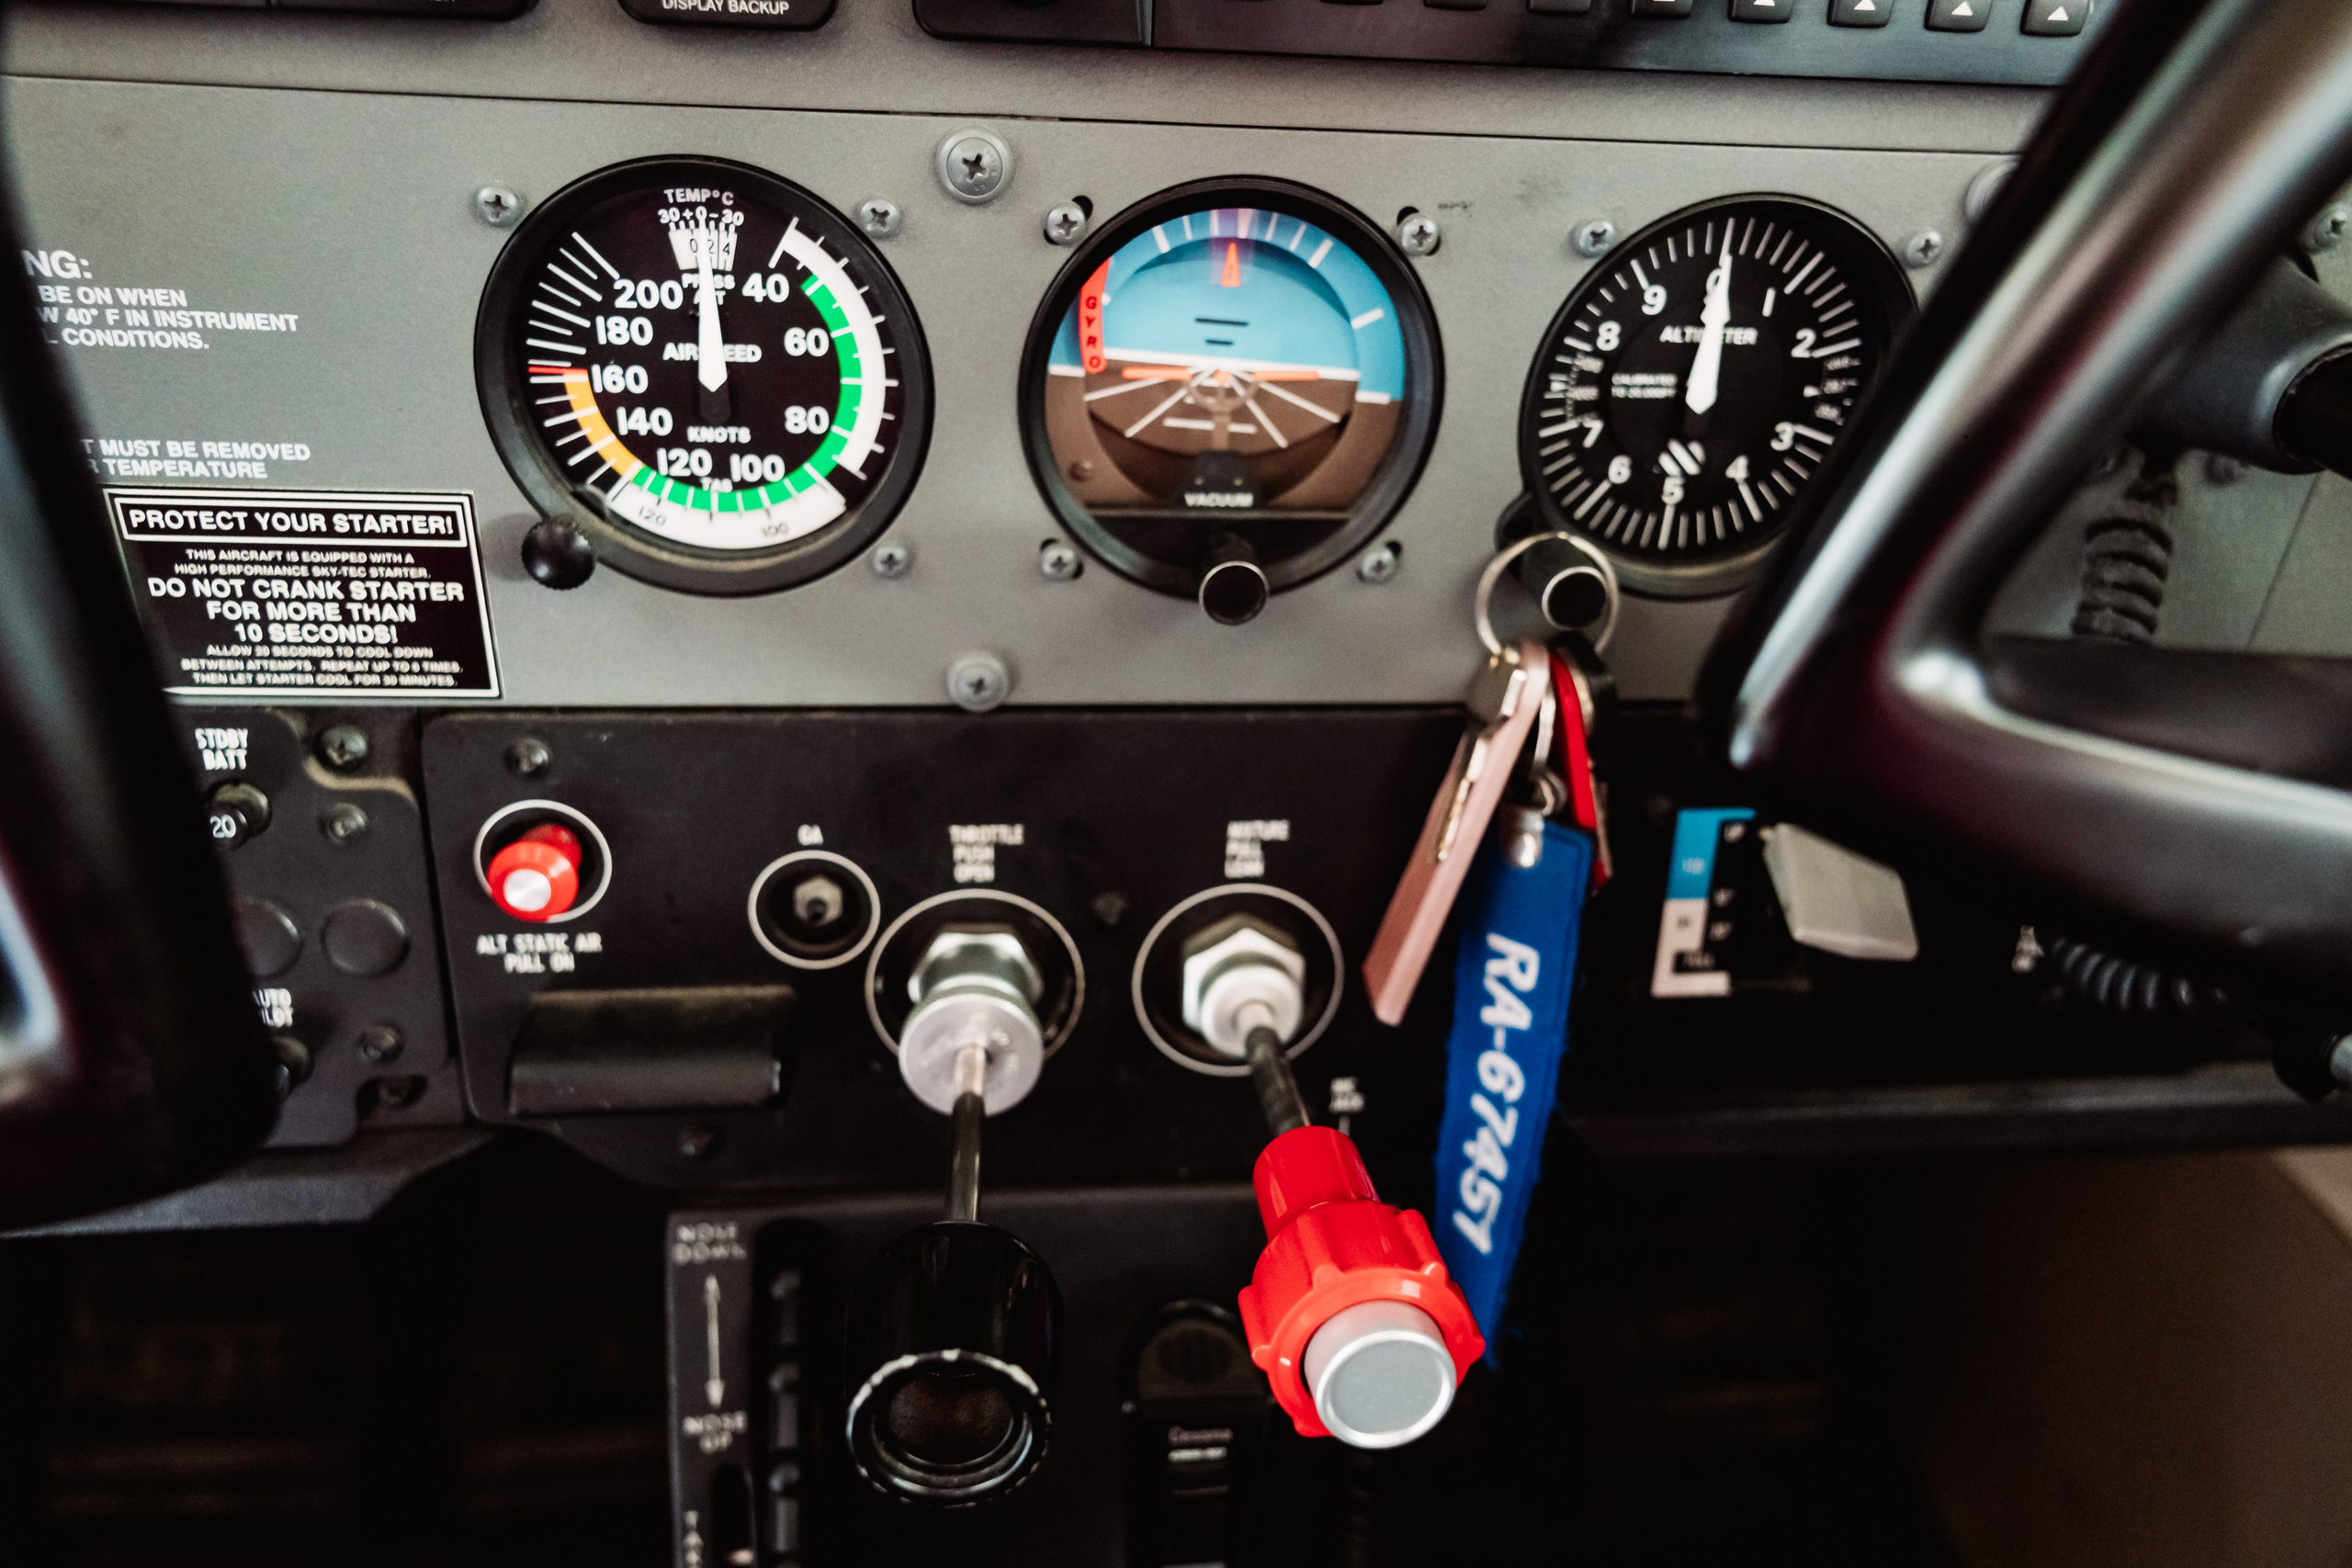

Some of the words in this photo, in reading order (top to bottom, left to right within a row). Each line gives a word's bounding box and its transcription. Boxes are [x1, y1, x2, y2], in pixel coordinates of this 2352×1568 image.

[662, 0, 723, 12] DISPLAY
[728, 0, 789, 15] BACKUP
[722, 242, 730, 256] 4
[681, 273, 735, 289] PRSS
[741, 273, 790, 303] 40
[38, 285, 74, 304] BE
[76, 286, 113, 305] ON
[114, 288, 187, 307] WHEN
[613, 278, 684, 310] 200
[1642, 285, 1667, 315] 9
[1762, 287, 1776, 317] 1
[65, 308, 98, 326] 40°
[105, 309, 119, 326] F
[124, 310, 150, 327] IN
[153, 310, 299, 332] INSTRUMENT
[594, 315, 654, 346] 180
[1085, 296, 1101, 368] GYRO
[62, 327, 210, 349] CONDITIONS.
[784, 327, 829, 357] 60
[1596, 321, 1621, 351] 8
[1791, 328, 1816, 357] 2
[662, 342, 763, 363] AIREED
[591, 364, 649, 394] 160
[616, 406, 673, 437] 140
[785, 405, 830, 435] 80
[686, 425, 752, 444] KNOTS
[1582, 418, 1604, 447] 7
[1770, 421, 1794, 451] 3
[99, 439, 160, 457] MUST
[166, 441, 198, 458] BE
[202, 441, 311, 460] REMOVED
[103, 458, 267, 479] TEMPERATURE
[656, 446, 713, 477] 120
[729, 453, 786, 483] 100
[1608, 455, 1632, 484] 6
[1725, 456, 1749, 479] 4
[1184, 491, 1253, 508] VACUUM
[1661, 476, 1685, 504] 5
[129, 509, 248, 531] PROTECT
[254, 512, 326, 533] YOUR
[332, 513, 455, 535] STARTER!
[639, 507, 667, 526] 120
[762, 523, 789, 537] 100
[186, 548, 216, 561] THIS
[219, 549, 283, 562] AIRCRAFT
[286, 551, 300, 563] IS
[300, 550, 368, 563] EQUIPPED
[368, 551, 402, 563] WITH
[404, 552, 414, 564] A
[174, 563, 208, 575] HIGH
[209, 563, 310, 577] PERFORMANCE
[311, 566, 368, 578] SKY-TEC
[147, 577, 187, 598] DO
[193, 578, 245, 598] NOT
[253, 579, 345, 600] CRANK
[349, 581, 465, 602] STARTER
[206, 600, 261, 621] FOR
[266, 601, 343, 622] MORE
[346, 603, 416, 623] THAN
[234, 623, 263, 642] 10
[267, 623, 399, 644] SECONDS!
[206, 644, 253, 657] ALLOW
[271, 645, 334, 658] SECONDS
[335, 646, 355, 659] TO
[355, 646, 392, 659] COOL
[392, 646, 434, 659] DOWN
[181, 658, 244, 671] BETWEEN
[320, 660, 369, 672] REPEAT
[371, 660, 390, 673] UP
[391, 660, 410, 673] TO
[192, 671, 228, 685] THEN
[230, 672, 254, 685] LET
[254, 672, 314, 685] STARTER
[314, 672, 352, 686] COOL
[353, 673, 380, 686] FOR
[195, 728, 248, 750] STDBY
[202, 749, 247, 770] BATT
[209, 814, 236, 838] 20
[476, 934, 508, 955] ALT
[513, 932, 570, 953] STATIC
[574, 931, 603, 953] AIR
[503, 952, 546, 974] PULL
[549, 951, 575, 972] ON
[1452, 931, 1540, 1255] RA-67451
